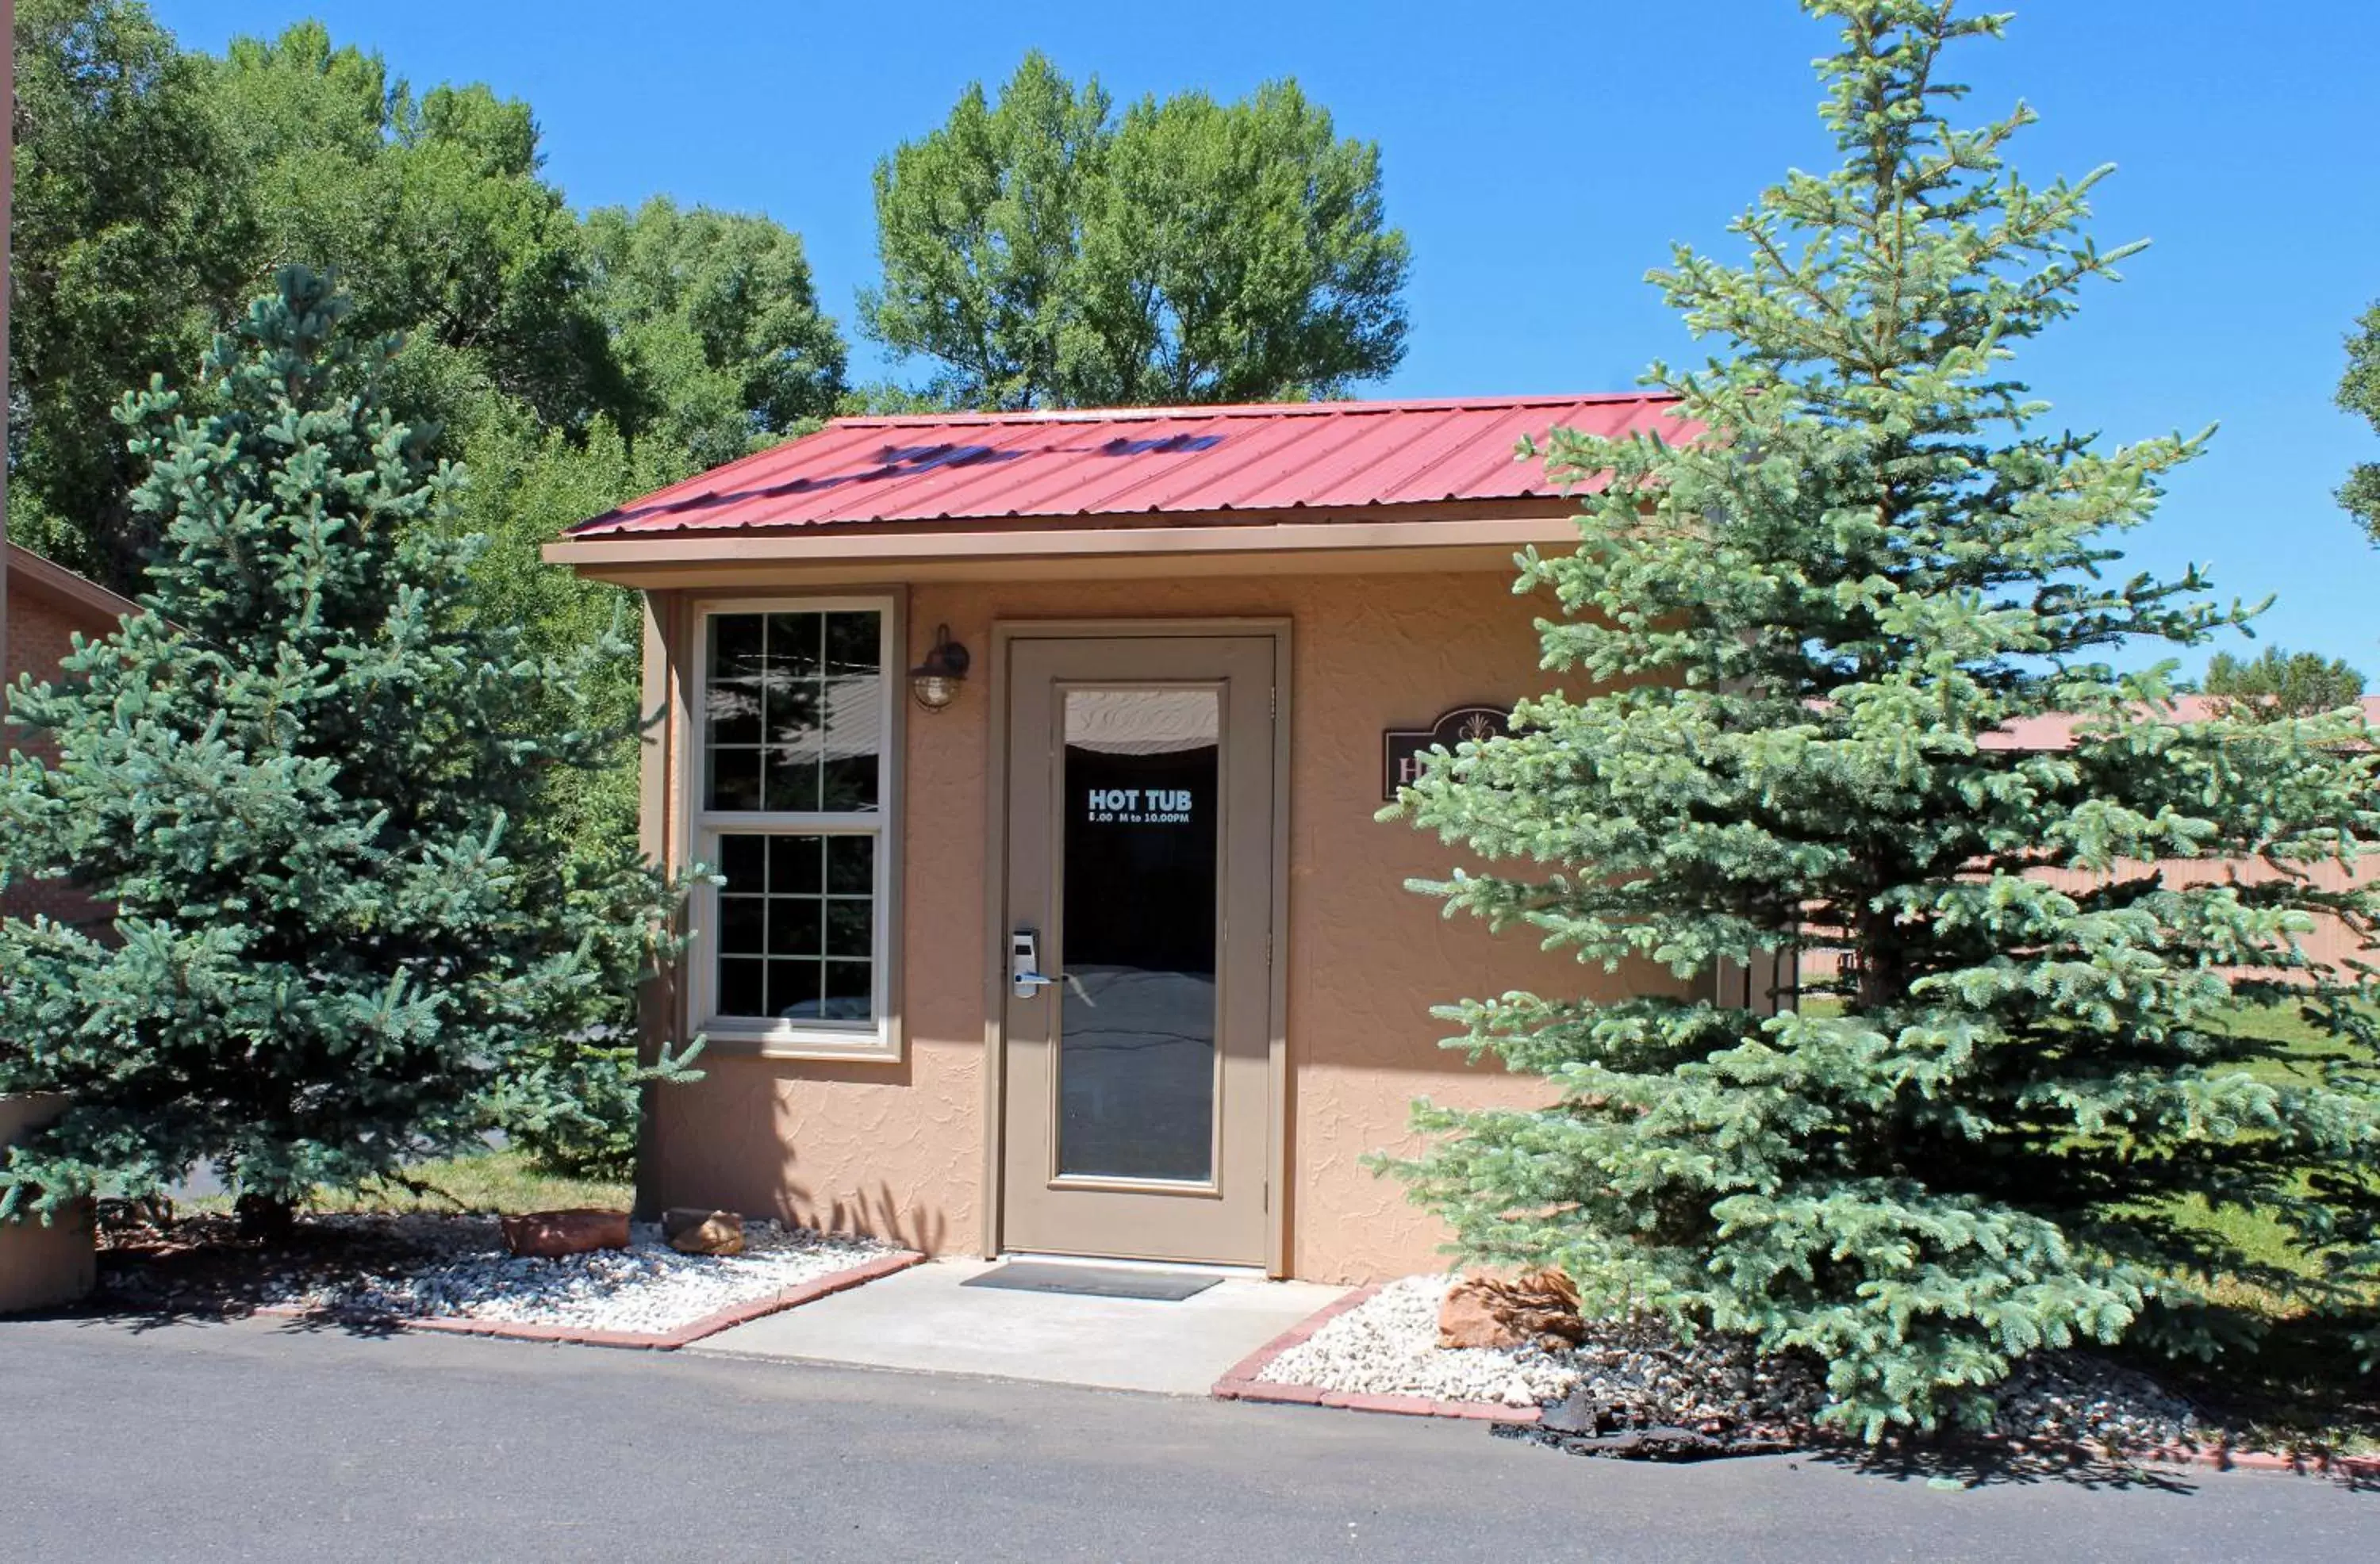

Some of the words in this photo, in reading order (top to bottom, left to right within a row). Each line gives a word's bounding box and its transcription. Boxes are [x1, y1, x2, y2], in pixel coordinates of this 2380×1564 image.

[1088, 789, 1139, 811] HOT
[1145, 790, 1192, 811] TUB
[1130, 813, 1141, 822] to
